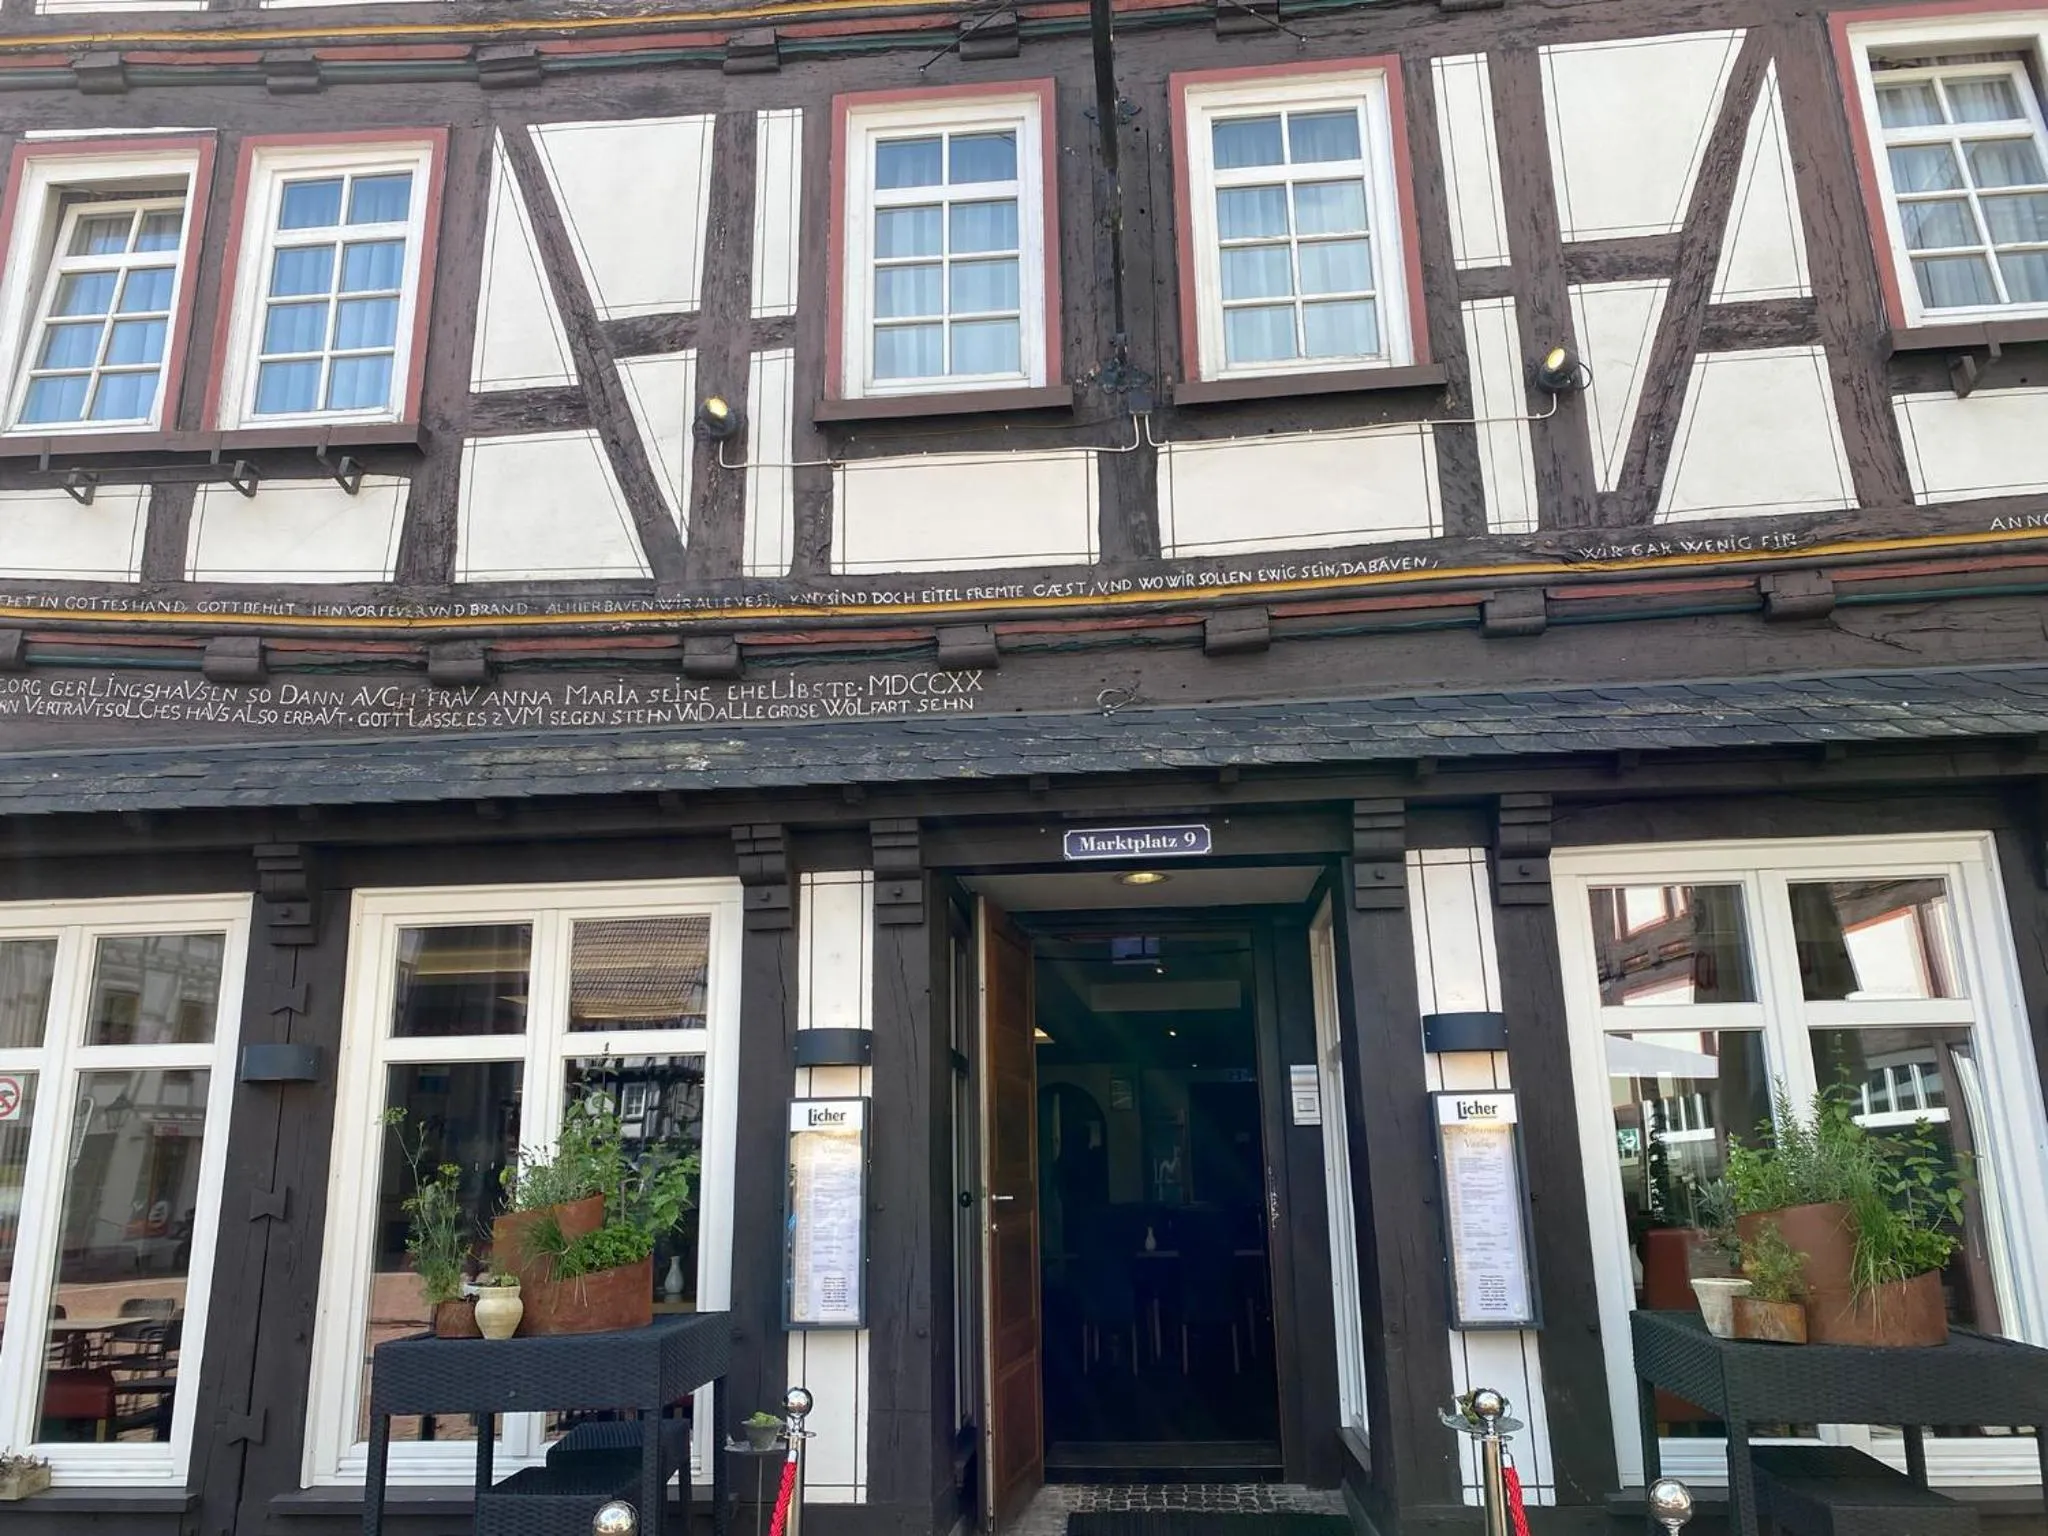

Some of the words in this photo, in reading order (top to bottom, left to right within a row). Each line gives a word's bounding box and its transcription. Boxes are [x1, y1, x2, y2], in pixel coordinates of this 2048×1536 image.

[868, 669, 984, 696] MDCCXX
[1078, 834, 1178, 853] Marktplatz
[1183, 831, 1197, 847] 9
[807, 1107, 847, 1127] Licher
[1456, 1100, 1499, 1120] Licher
